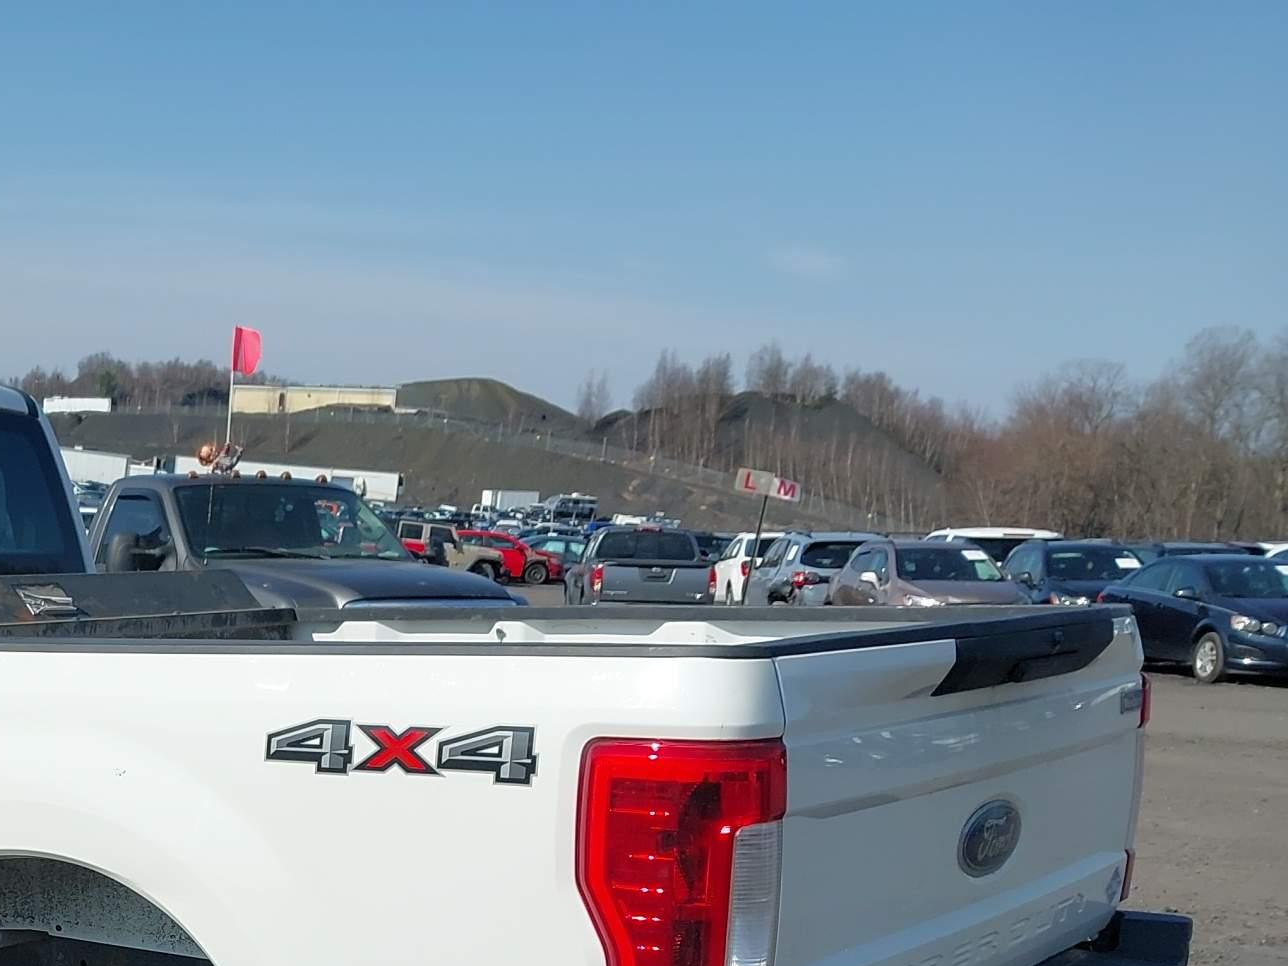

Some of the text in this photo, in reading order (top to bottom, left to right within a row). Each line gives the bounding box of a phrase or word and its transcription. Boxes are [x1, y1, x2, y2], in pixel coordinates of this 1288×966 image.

[744, 471, 756, 490] L
[777, 479, 796, 498] M
[1010, 892, 1086, 942] DUTY
